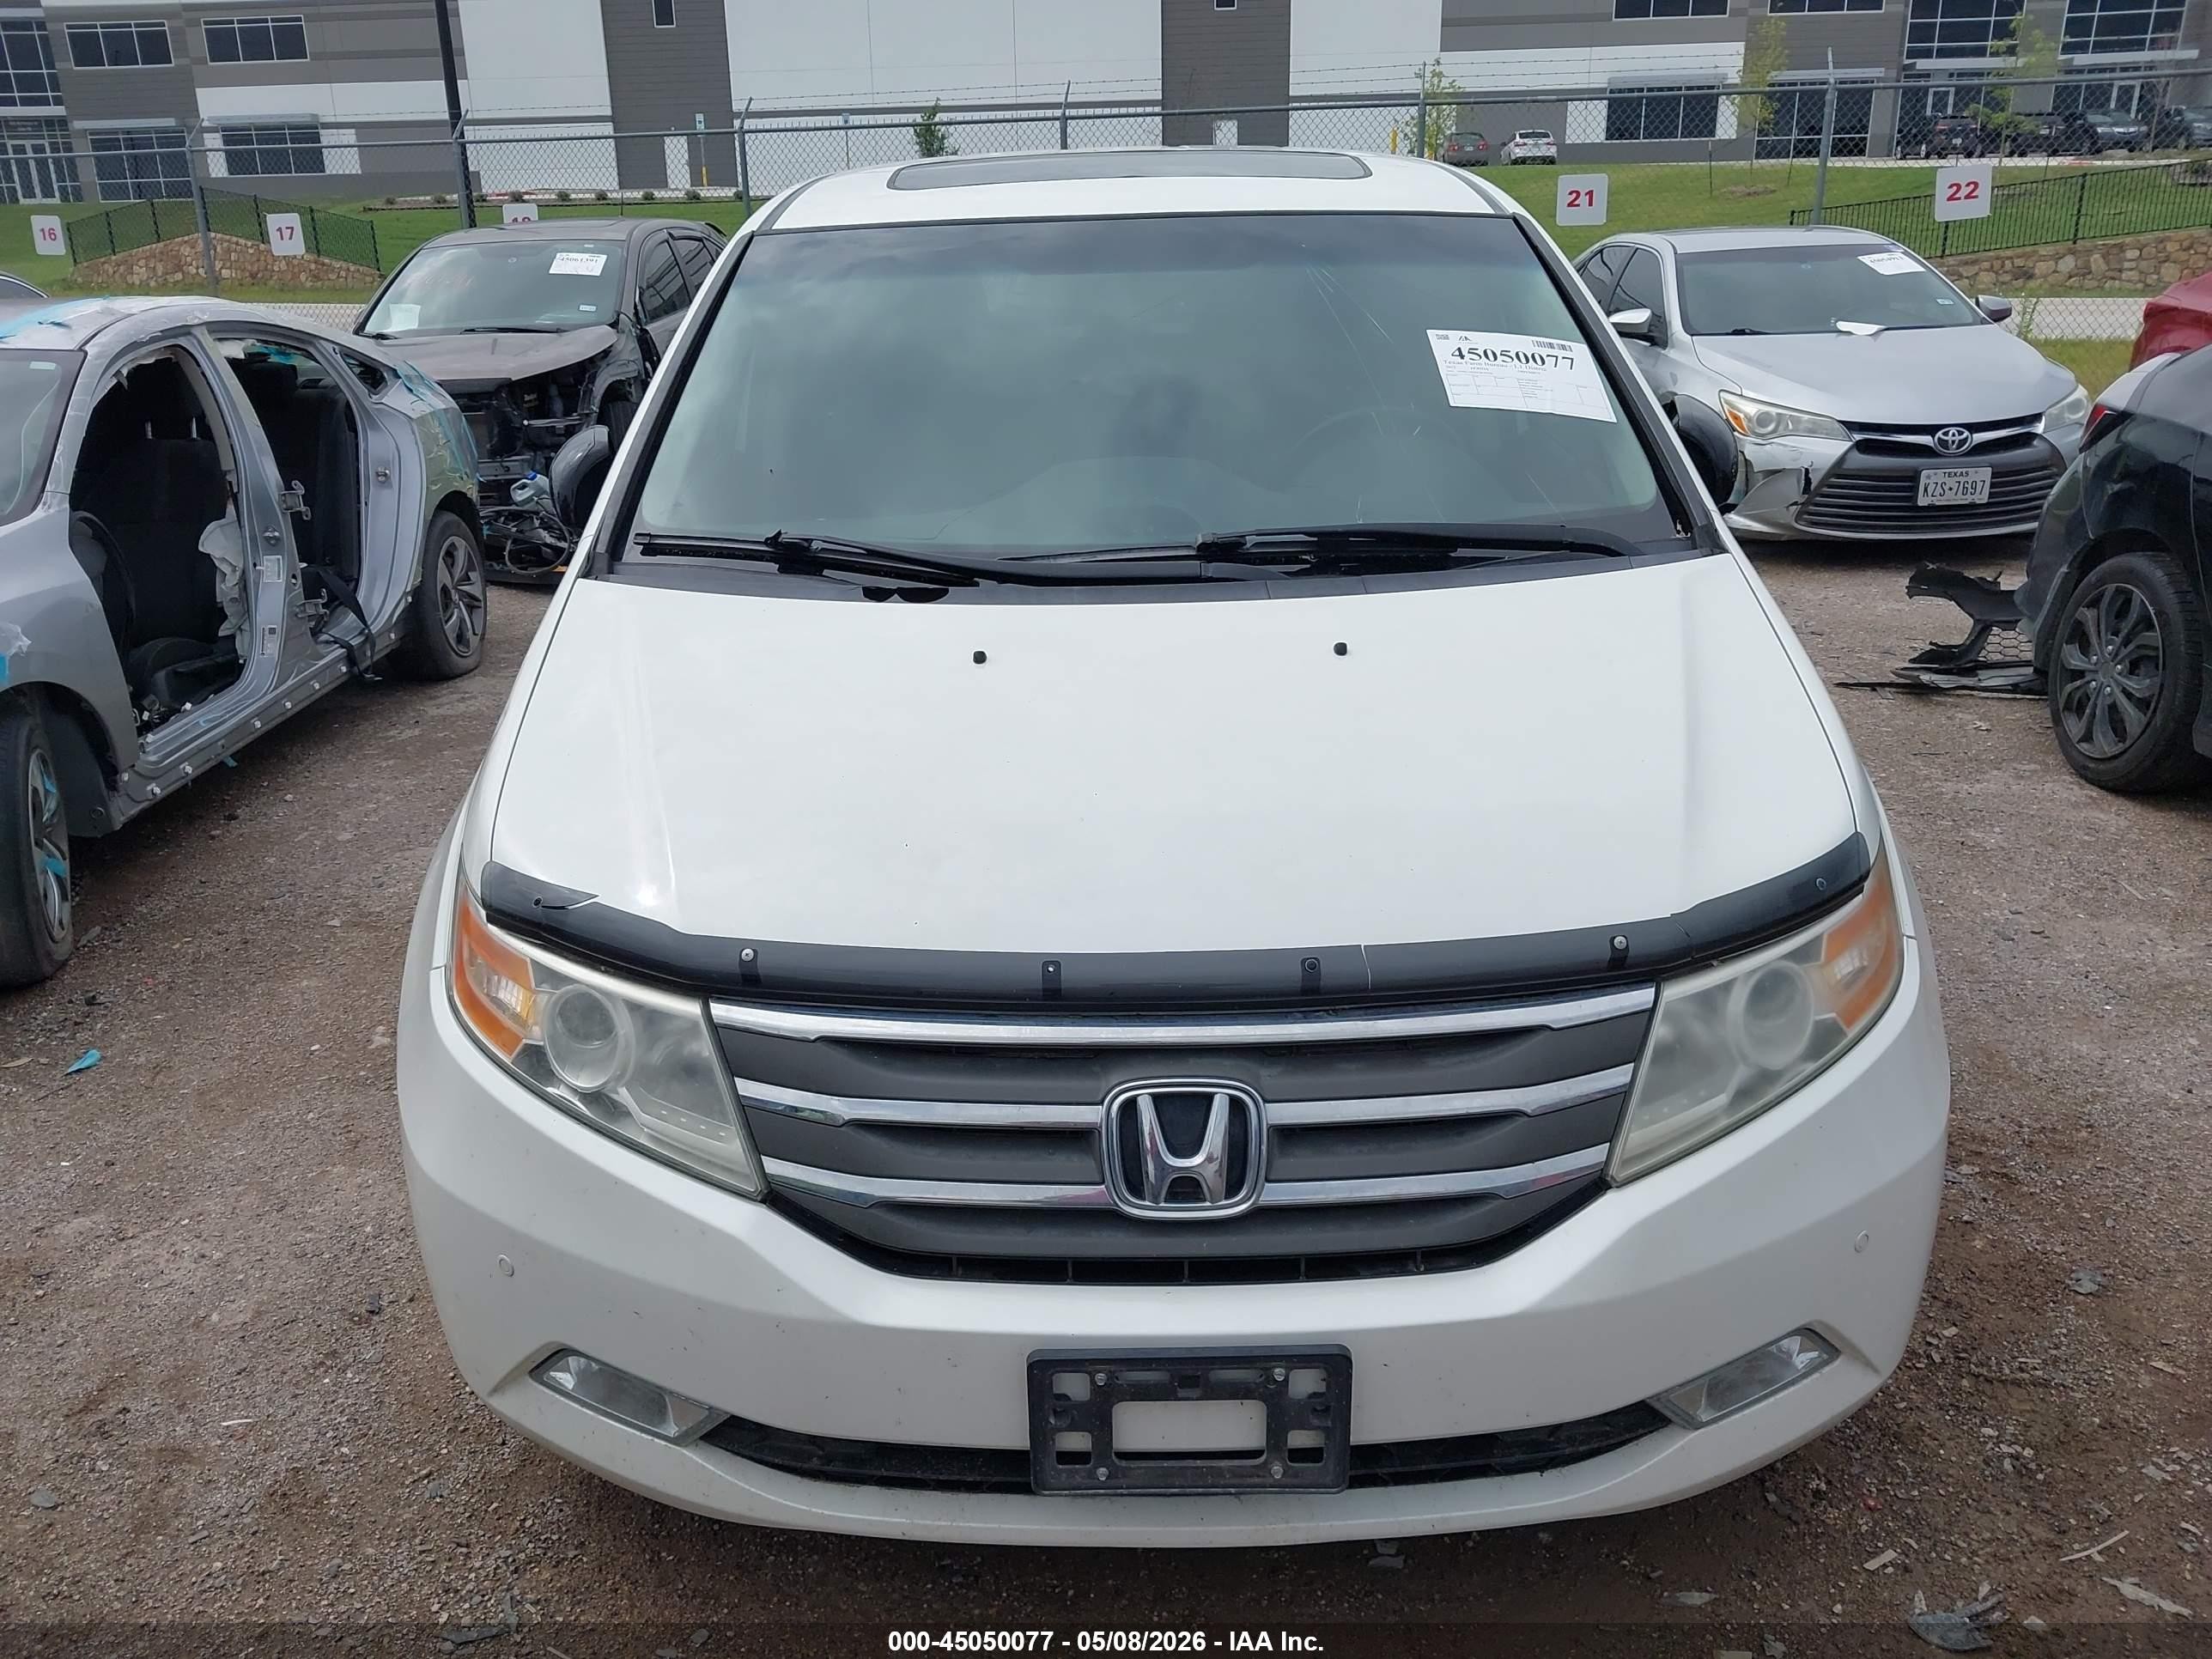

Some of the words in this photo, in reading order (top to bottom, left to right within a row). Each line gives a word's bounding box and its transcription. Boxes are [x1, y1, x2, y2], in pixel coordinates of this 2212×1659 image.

[1565, 189, 1595, 207] 21
[1946, 180, 1979, 202] 22
[40, 227, 57, 241] 16
[276, 226, 295, 241] 17
[1450, 346, 1575, 370] 45050077
